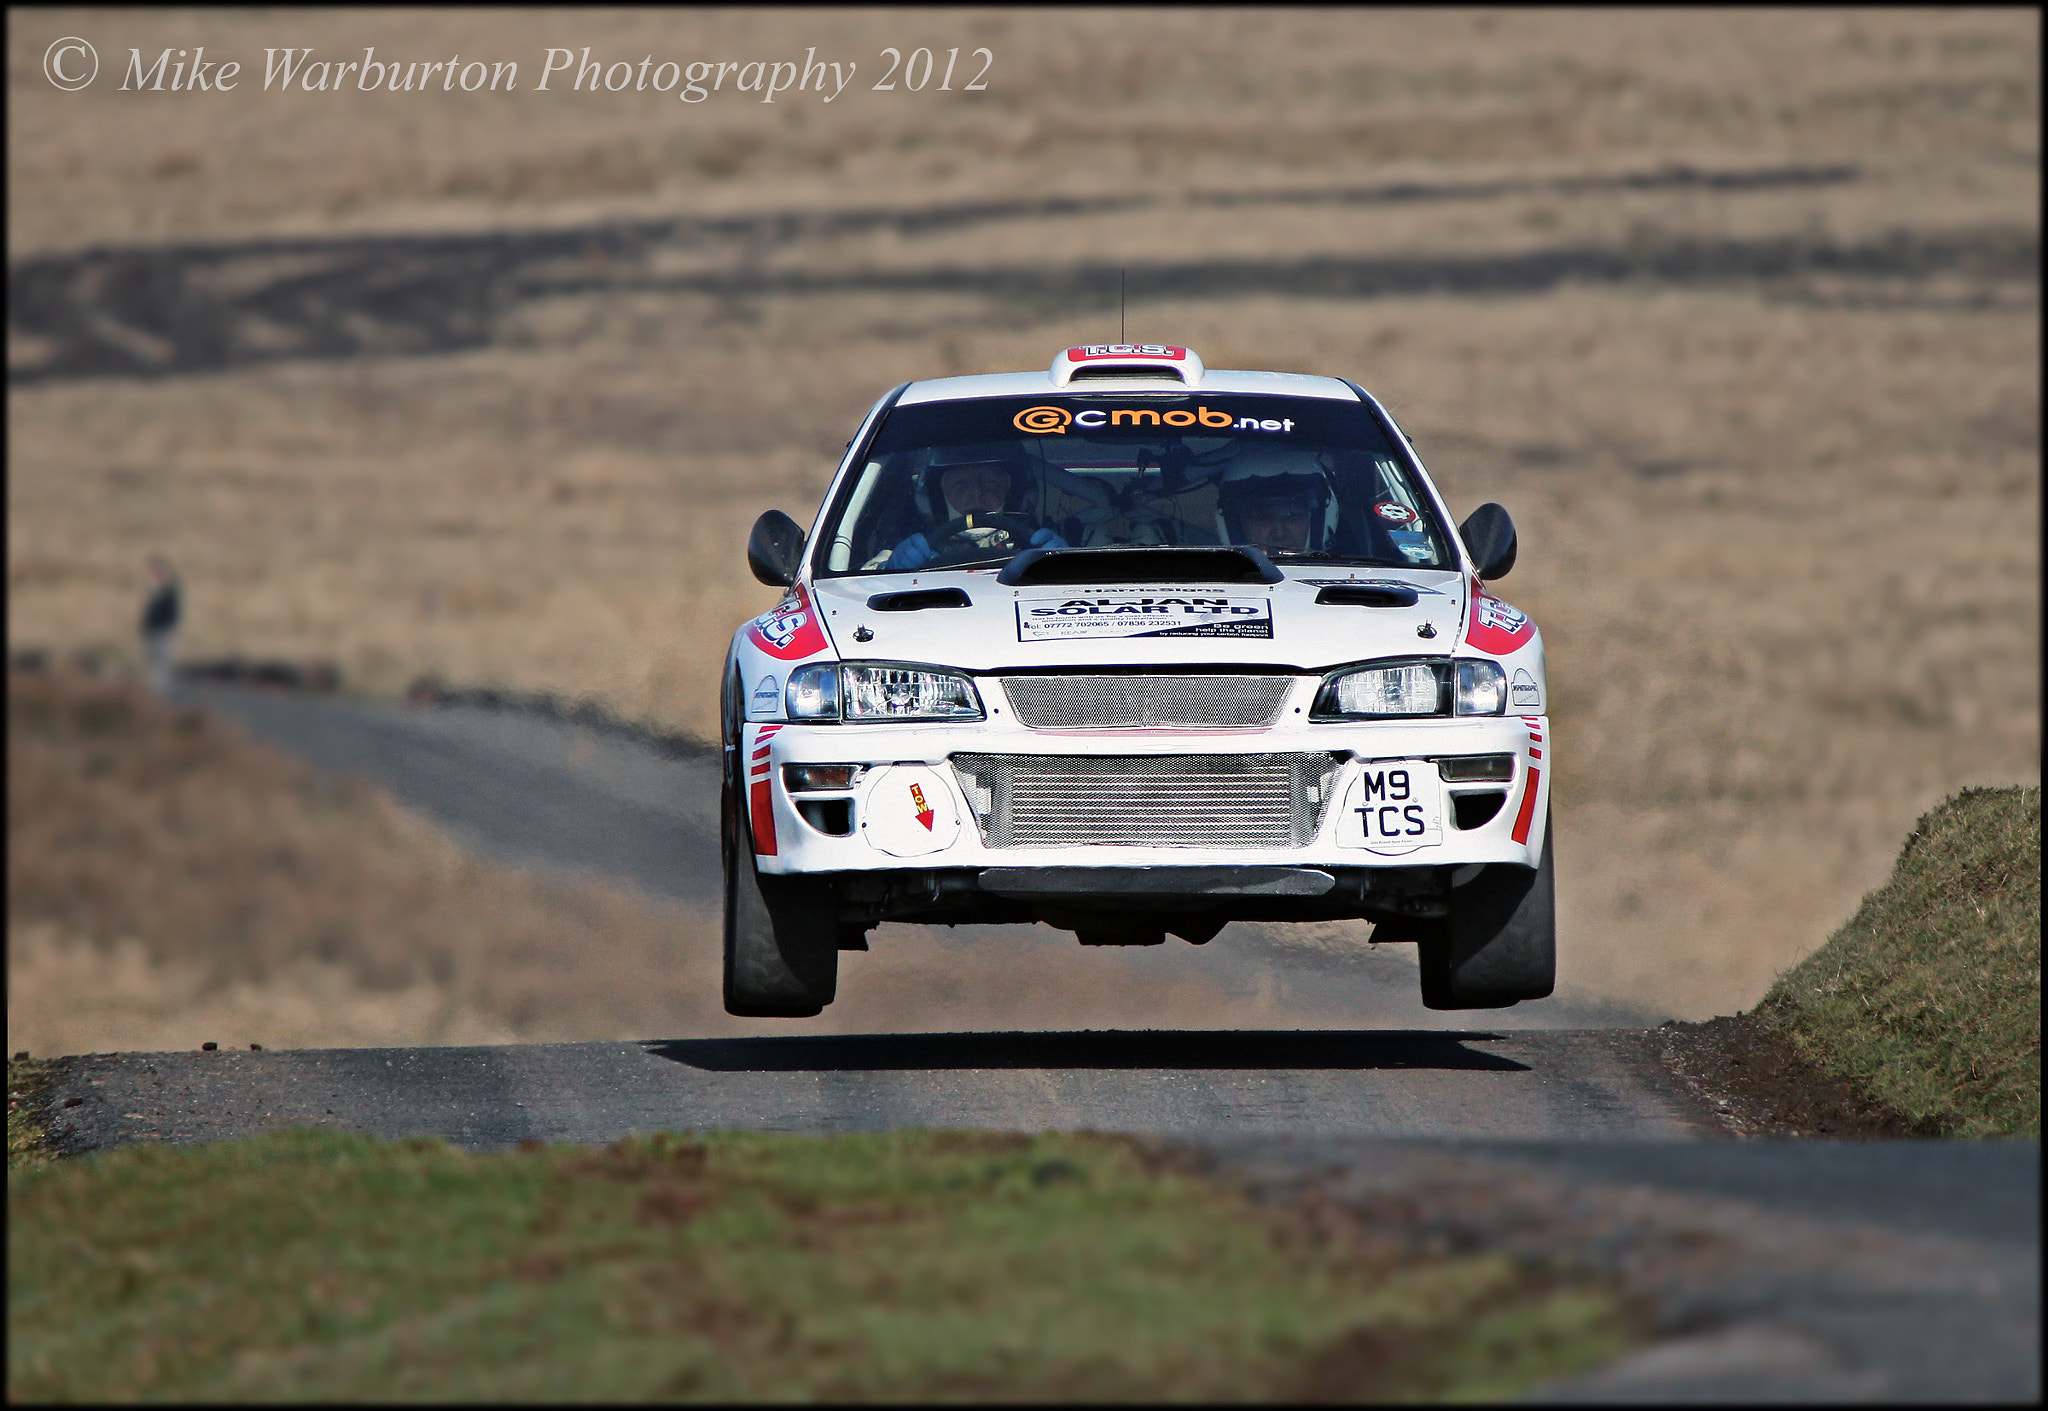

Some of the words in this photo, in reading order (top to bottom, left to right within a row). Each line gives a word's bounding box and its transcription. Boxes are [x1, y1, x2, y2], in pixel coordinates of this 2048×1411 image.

[1030, 606, 1169, 616] SOLAR
[1184, 606, 1259, 614] LTD
[1060, 598, 1228, 607] ALJAN
[911, 785, 928, 813] TOW
[1364, 770, 1410, 801] M9
[1354, 805, 1425, 837] TCS
